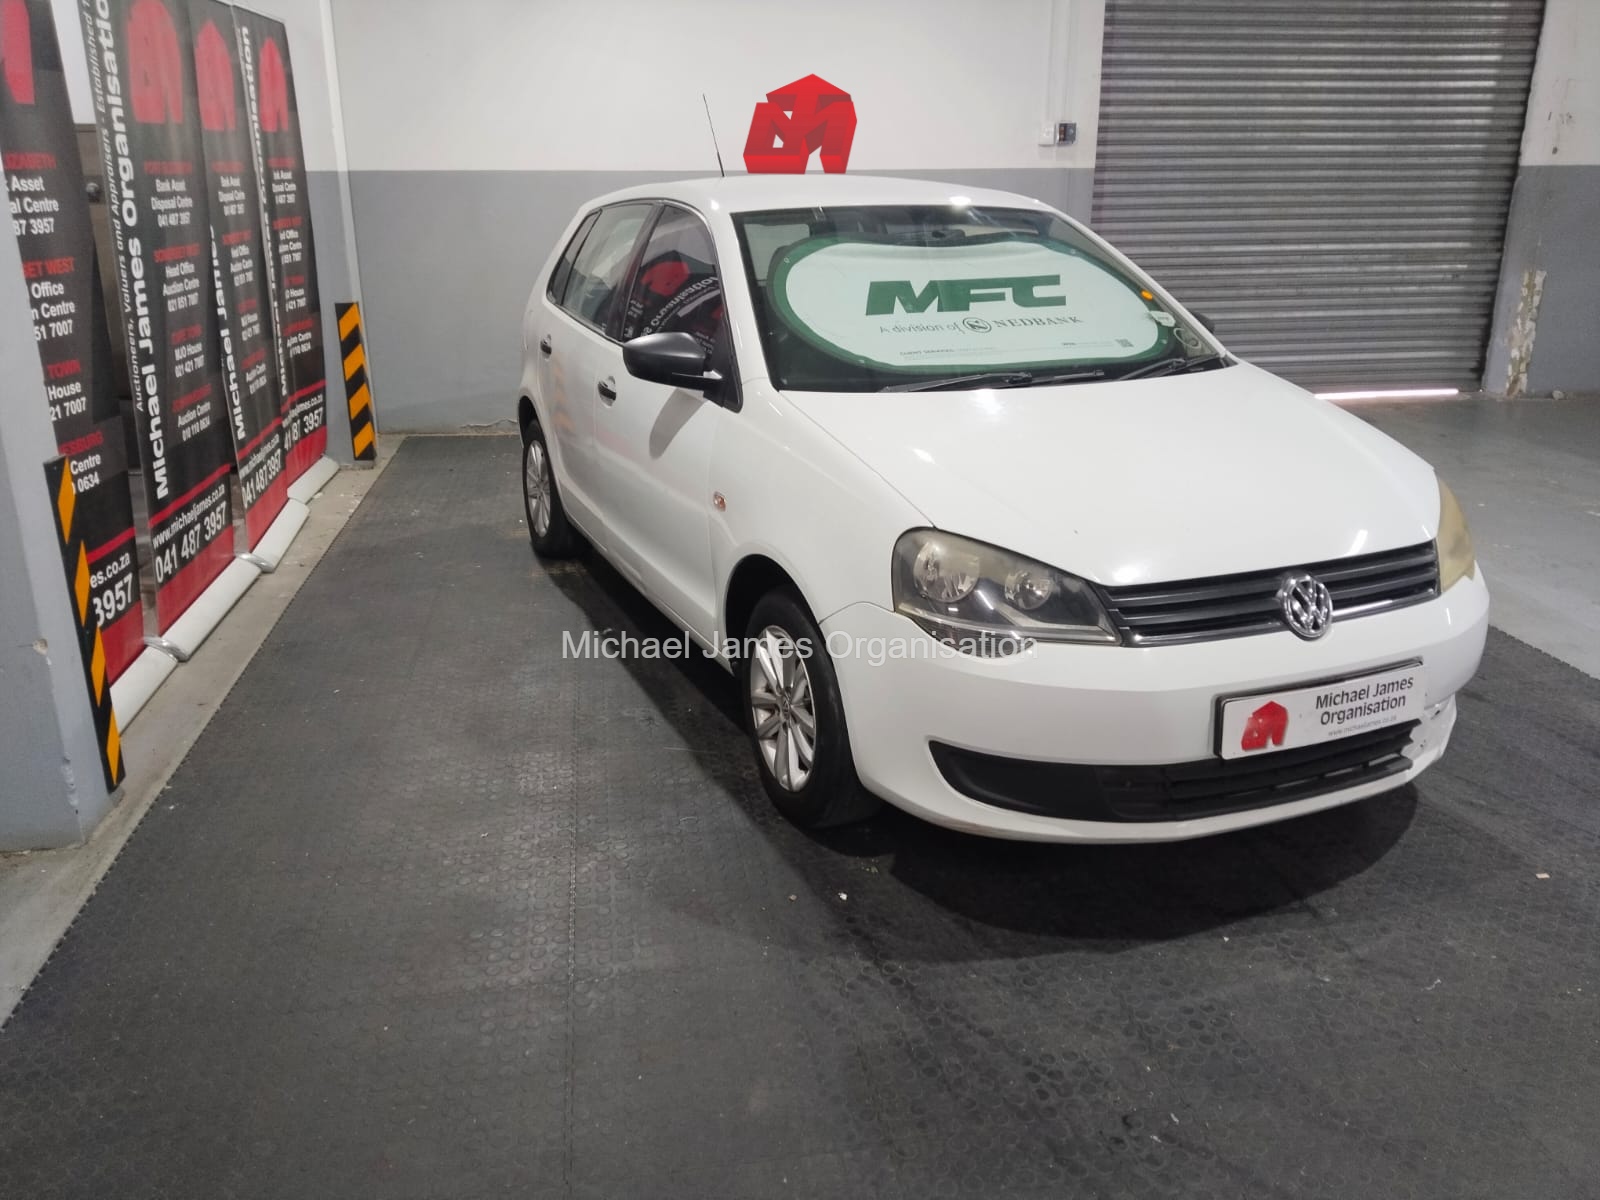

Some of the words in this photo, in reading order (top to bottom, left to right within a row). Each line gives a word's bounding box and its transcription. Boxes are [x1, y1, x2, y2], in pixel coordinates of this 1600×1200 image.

[83, 12, 106, 112] Established
[96, 0, 138, 227] Organisatio
[11, 175, 45, 192] Asset
[102, 128, 119, 216] Appraisers
[23, 196, 60, 214] Centre
[29, 217, 55, 235] 3957
[112, 218, 124, 251] and
[31, 281, 64, 298] Office
[118, 252, 131, 313] Valuers
[129, 237, 153, 354] James
[865, 274, 1067, 316] MFC
[41, 301, 76, 318] Centre
[879, 326, 890, 334] A
[892, 323, 944, 333] division
[946, 322, 965, 334] of
[993, 316, 1084, 328] NEDBANK
[49, 319, 73, 338] 7007
[128, 318, 144, 412] Auctioneers,
[47, 382, 82, 401] House
[220, 327, 246, 440] Michael
[63, 396, 87, 417] 7007
[303, 407, 324, 434] 3957
[141, 363, 168, 499] Michael
[70, 454, 101, 475] Centre
[77, 472, 100, 493] 0634
[153, 483, 225, 550] www.michaeljames.co.za
[155, 543, 178, 584] 041
[181, 522, 200, 559] 487
[204, 500, 226, 541] 3957
[93, 573, 134, 628] 3957
[1315, 684, 1370, 710] Michael
[1372, 677, 1414, 697] James
[1320, 695, 1406, 725] Organisation
